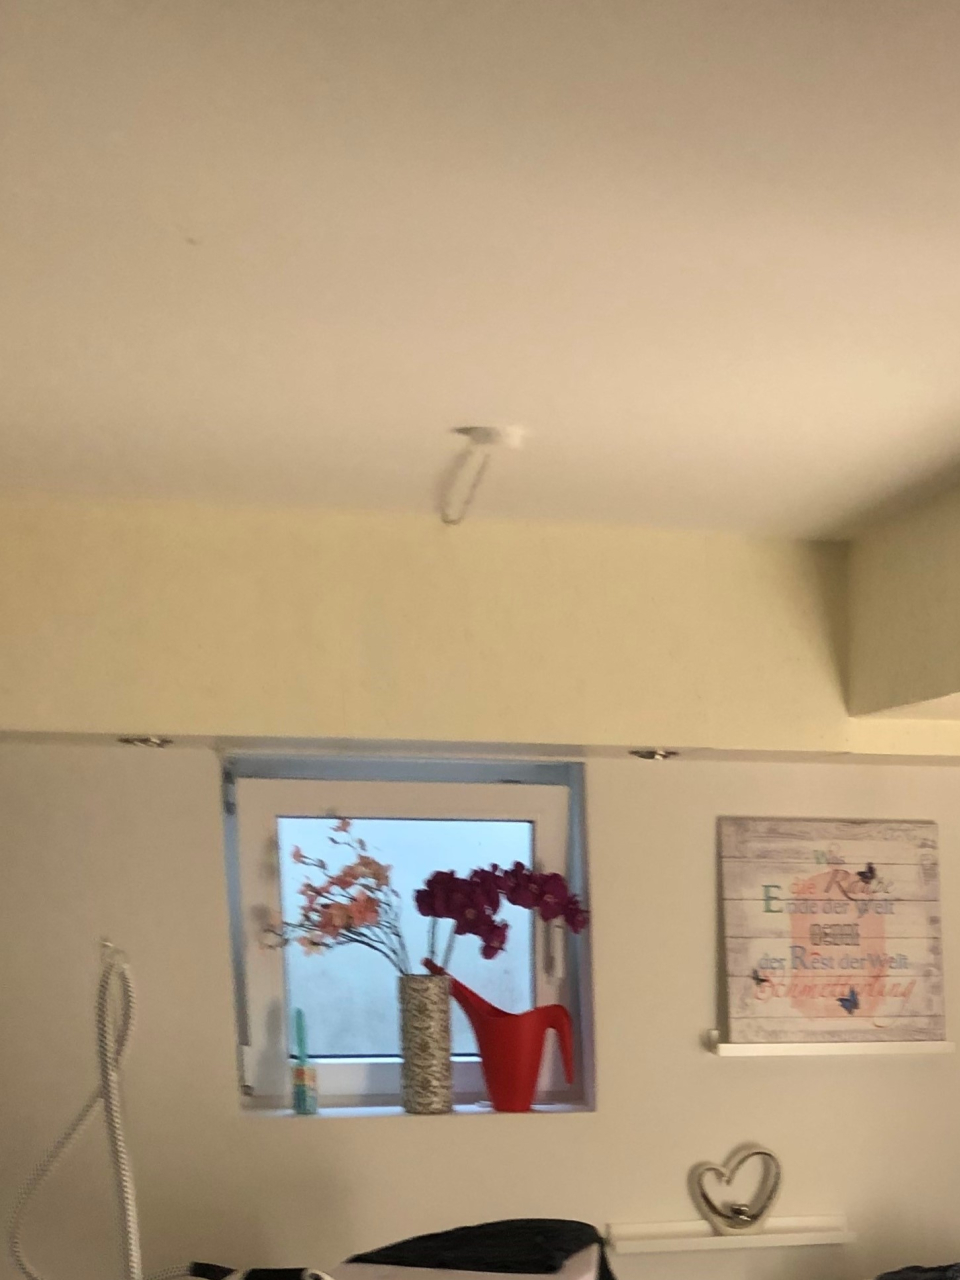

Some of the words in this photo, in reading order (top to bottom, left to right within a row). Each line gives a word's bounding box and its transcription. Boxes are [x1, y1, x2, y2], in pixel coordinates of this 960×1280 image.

[762, 885, 818, 914] Ende
[823, 898, 850, 914] der
[854, 898, 896, 918] Welt
[758, 952, 786, 970] der
[789, 945, 835, 970] Rest
[838, 952, 866, 970] der
[866, 952, 909, 970] Welt
